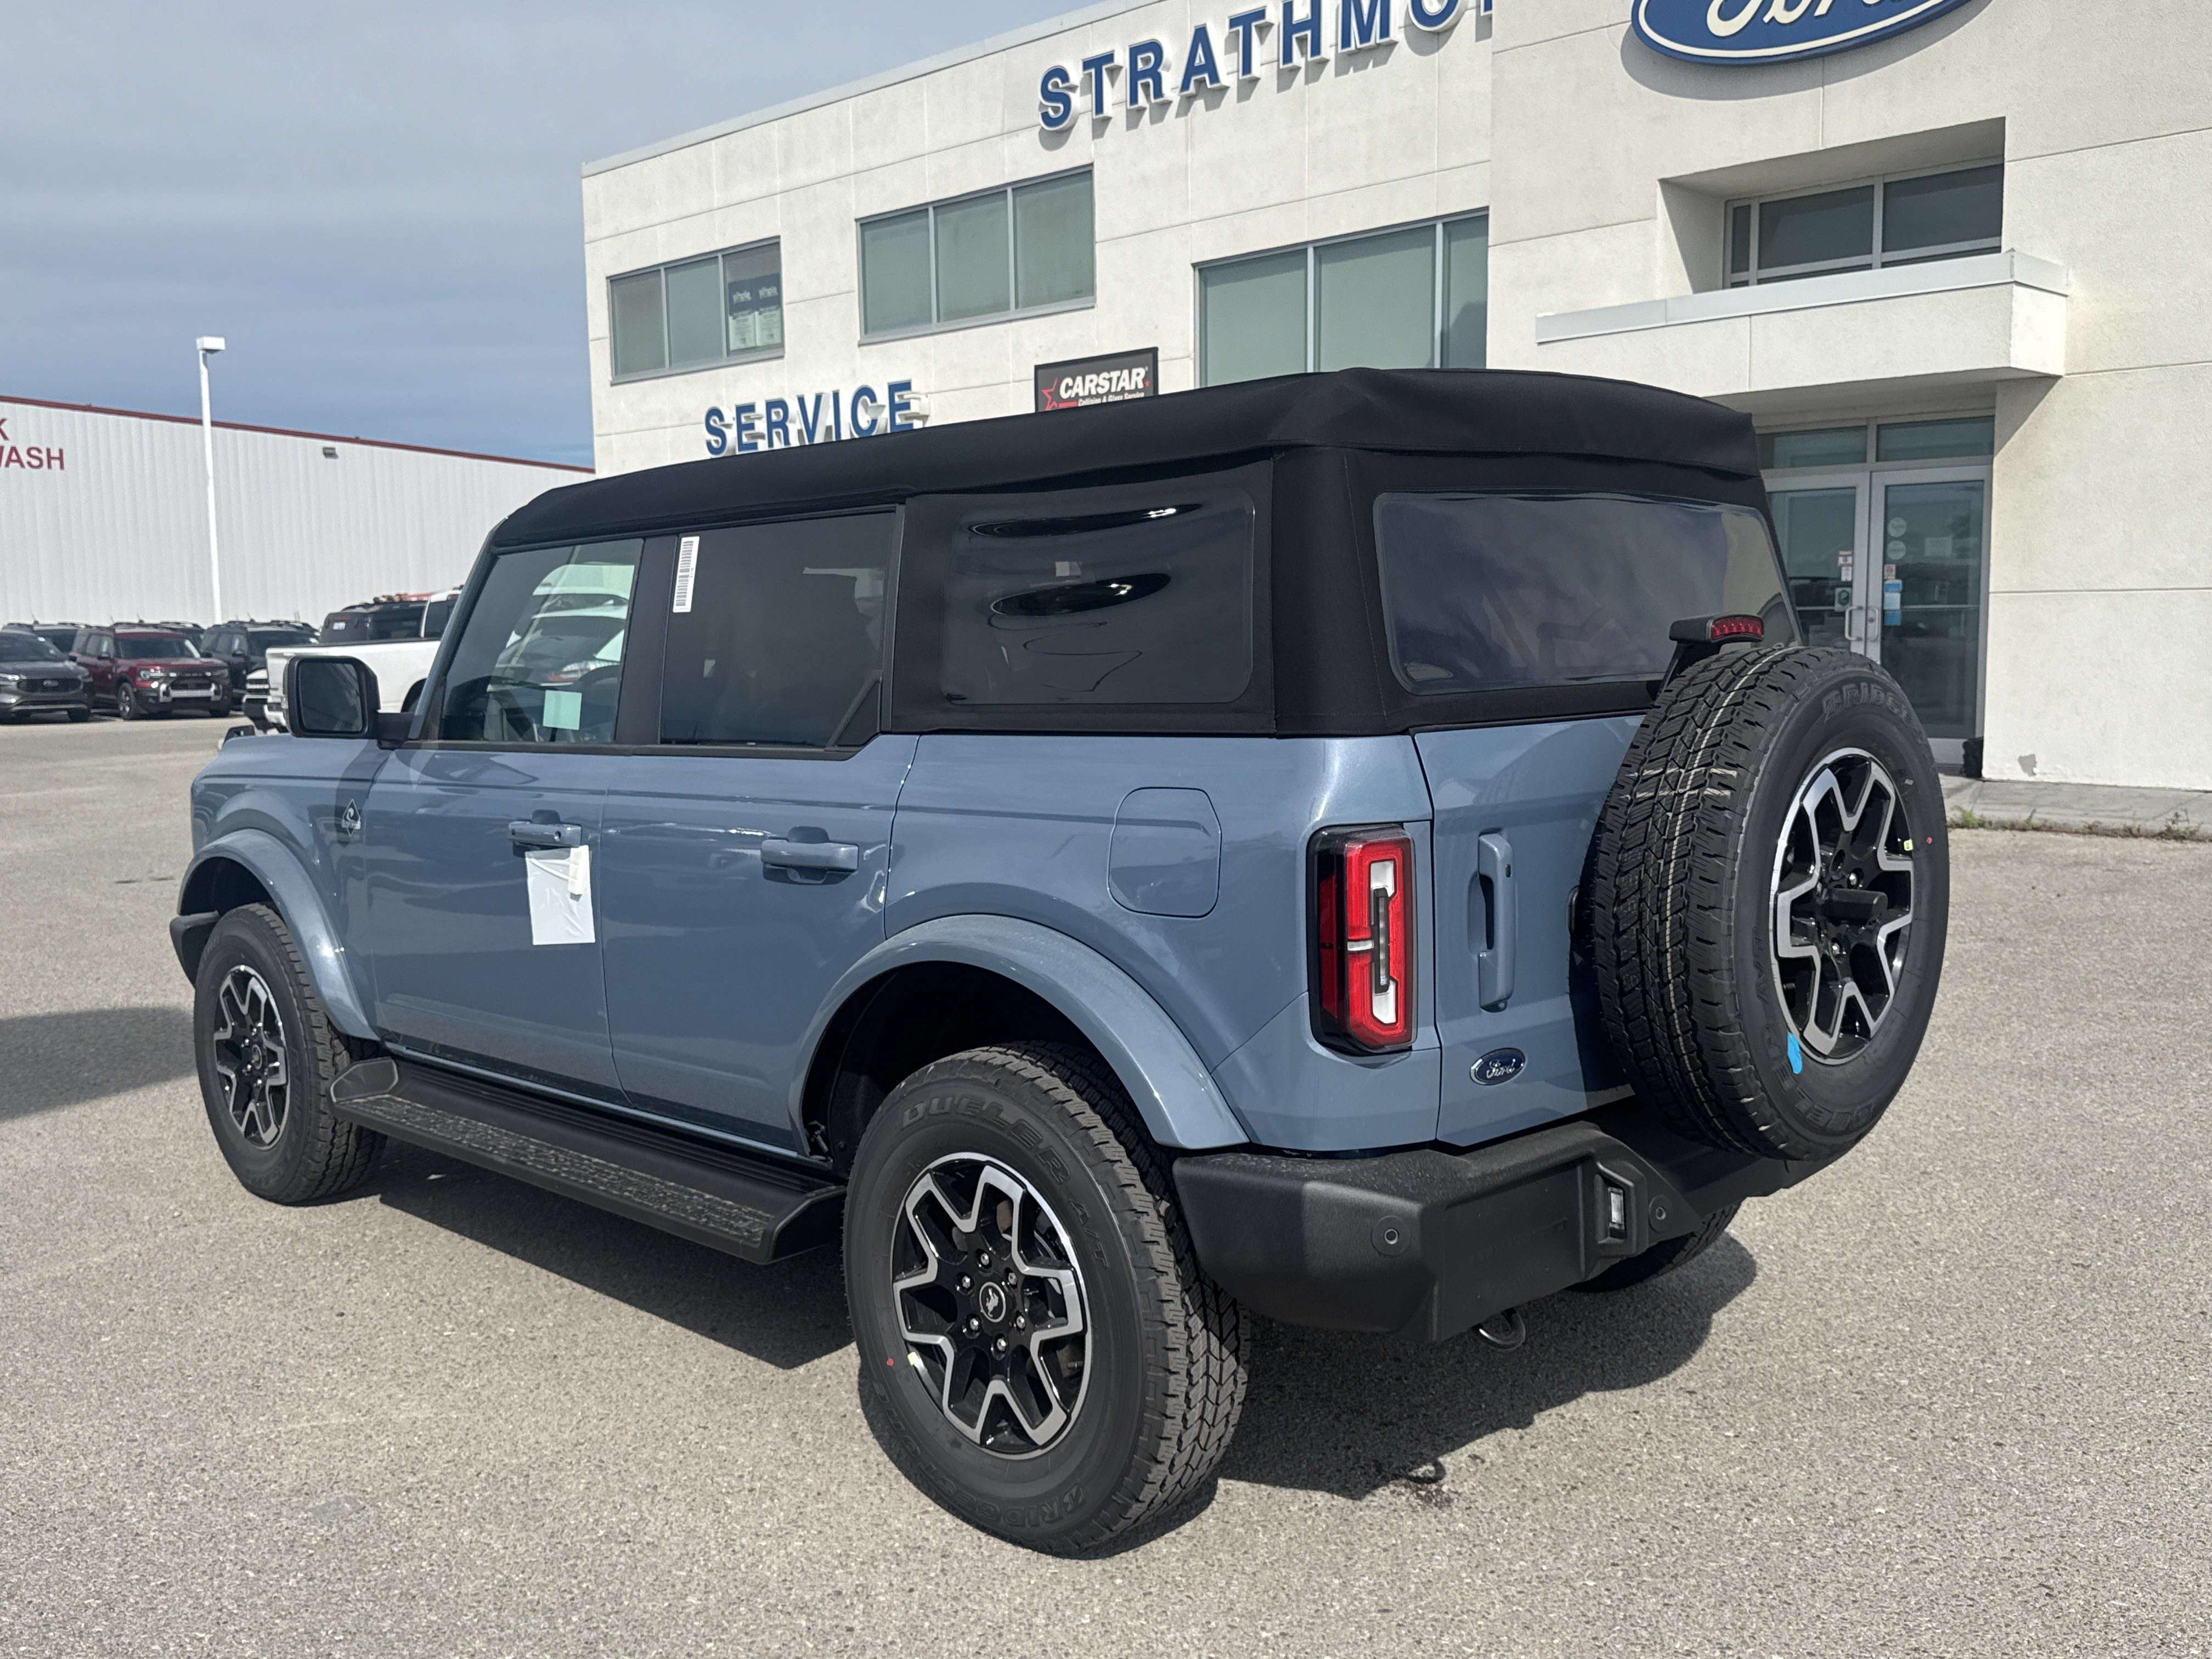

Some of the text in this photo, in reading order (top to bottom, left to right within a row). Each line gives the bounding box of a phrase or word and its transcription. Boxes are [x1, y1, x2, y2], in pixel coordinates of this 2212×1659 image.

[1039, 0, 1493, 131] STRATHM
[704, 379, 914, 457] SERVICE
[1059, 367, 1146, 399] CARSTAR
[901, 1093, 1071, 1185] DUELER
